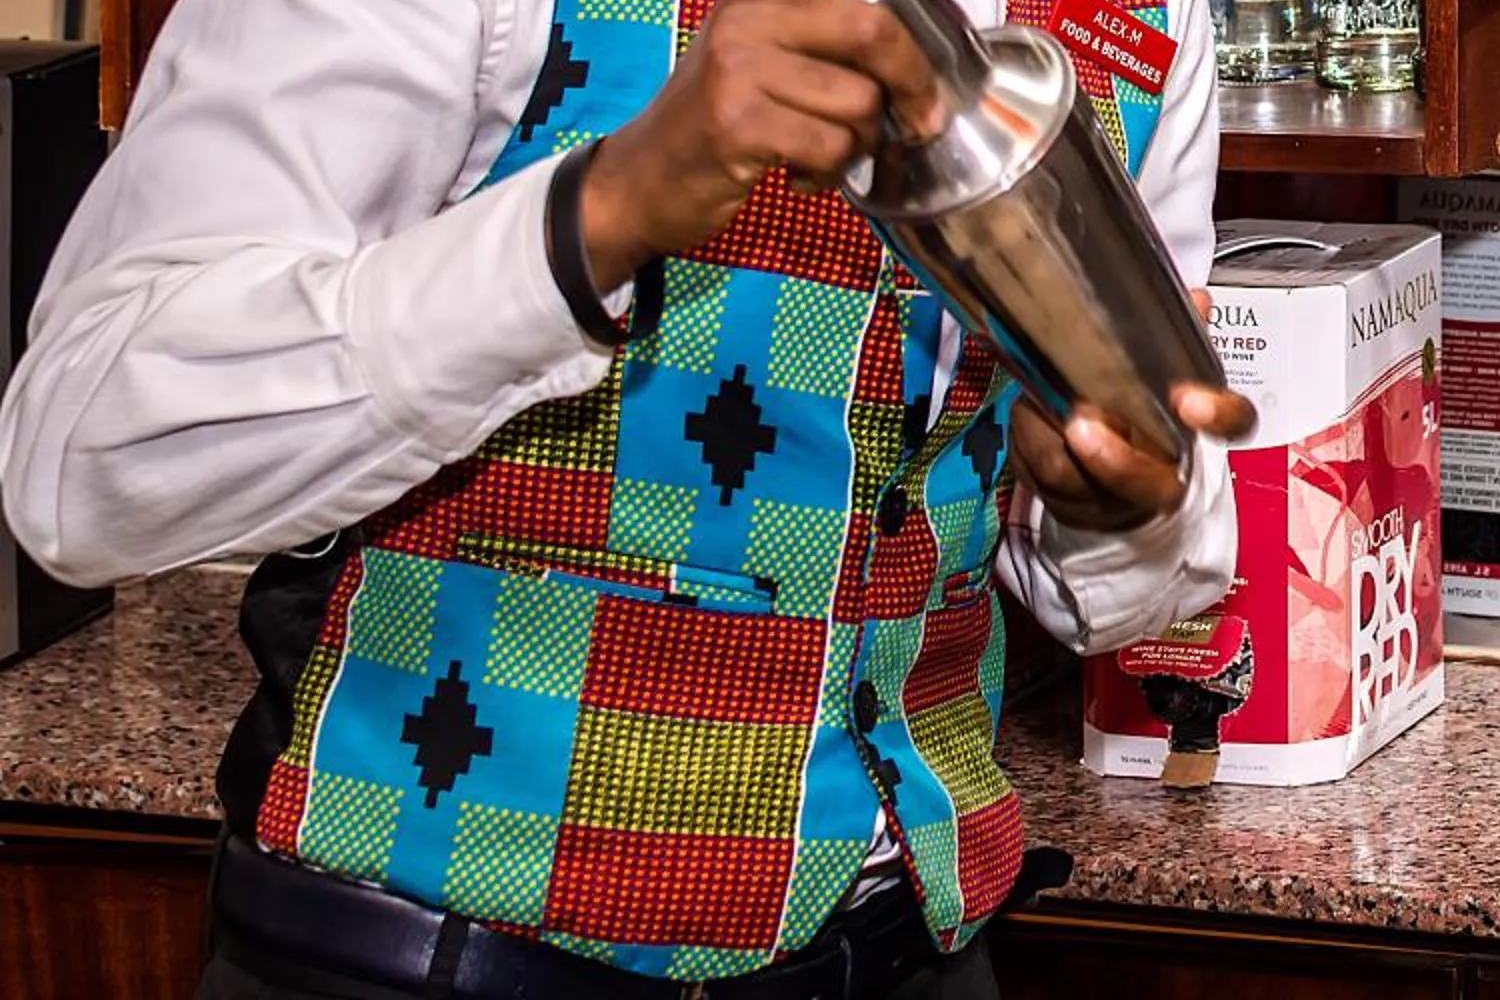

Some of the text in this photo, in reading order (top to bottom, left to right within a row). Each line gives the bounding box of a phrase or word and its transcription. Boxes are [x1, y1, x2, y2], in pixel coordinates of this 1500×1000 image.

[1060, 18, 1163, 84] FOOD & BEVERAGES
[1211, 336, 1267, 351] RY RED
[1351, 269, 1438, 349] NAMAQUA
[1351, 505, 1404, 558] SMOOTH
[1351, 519, 1422, 633] DRY
[1351, 612, 1419, 733] RED
